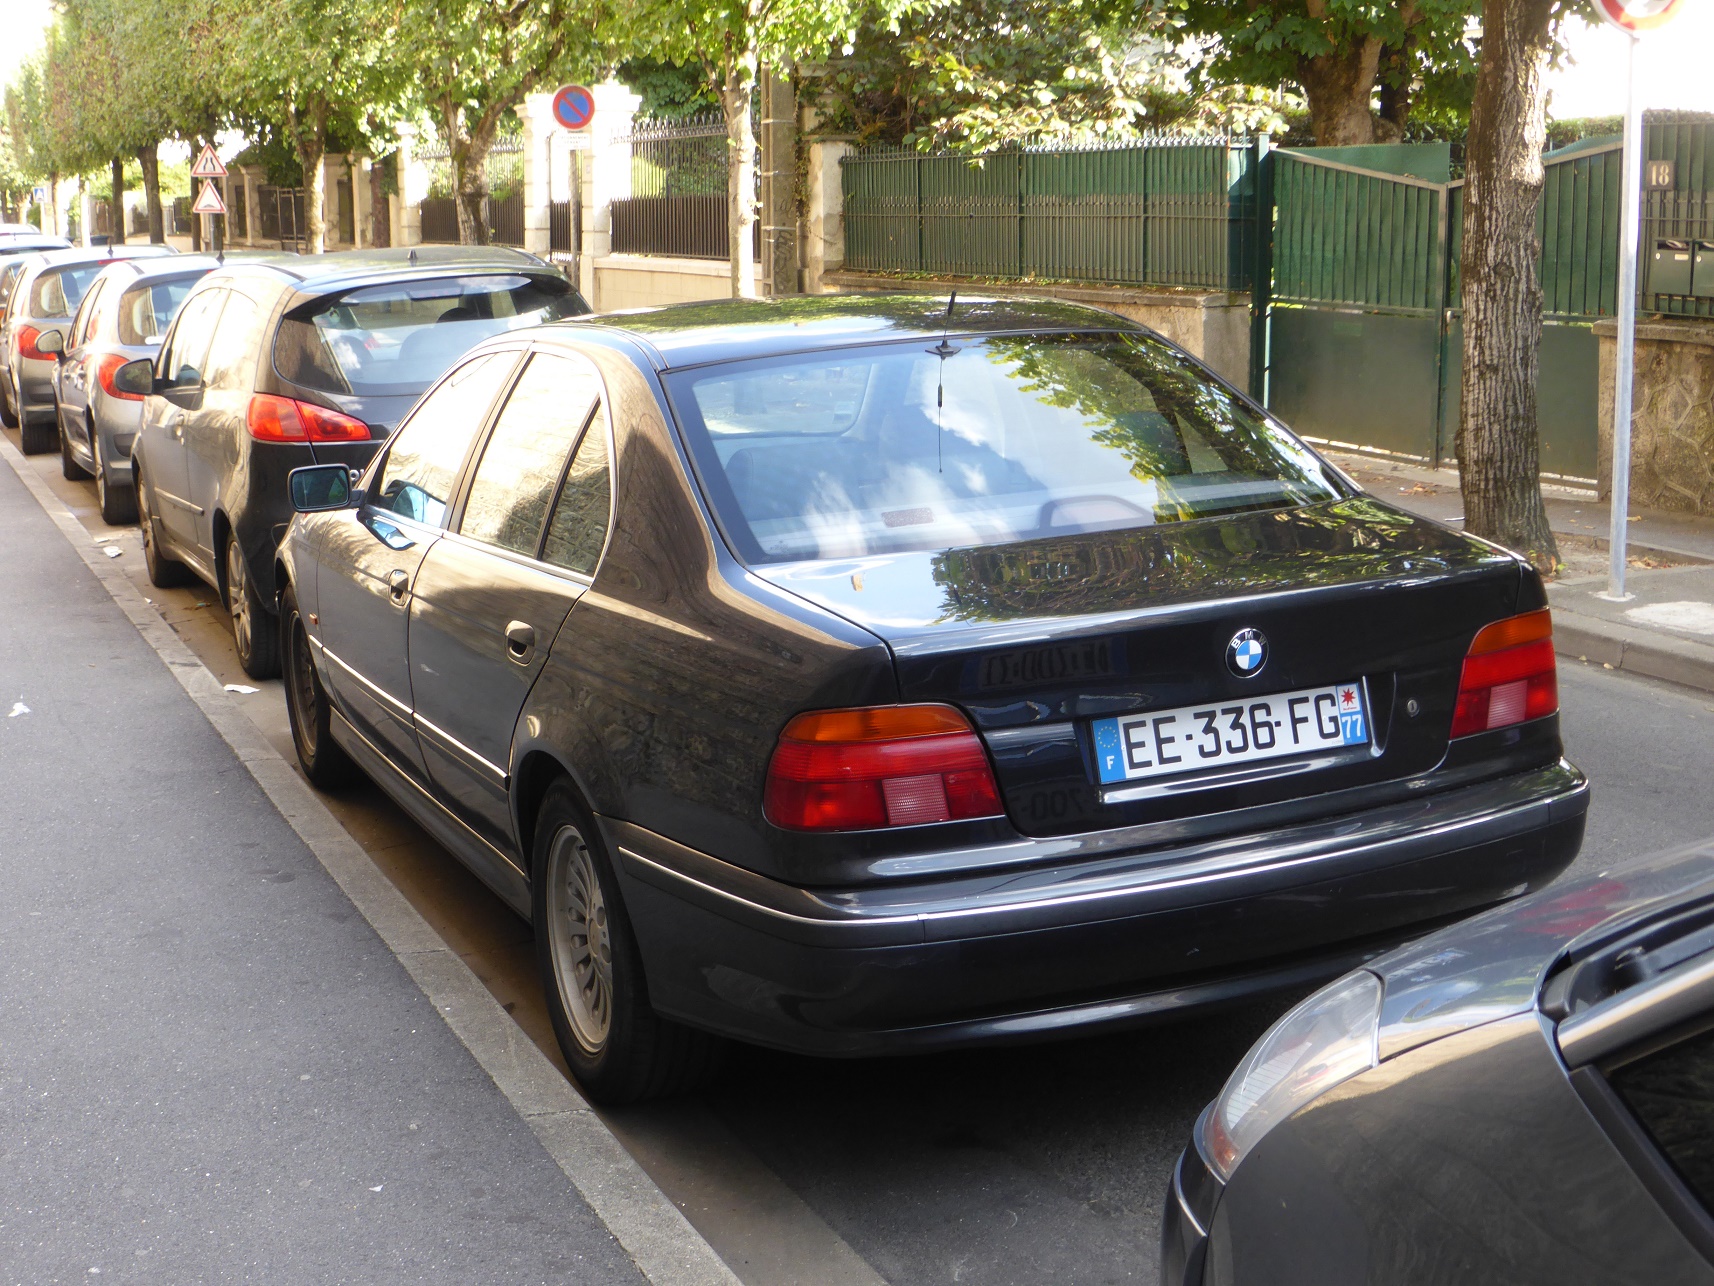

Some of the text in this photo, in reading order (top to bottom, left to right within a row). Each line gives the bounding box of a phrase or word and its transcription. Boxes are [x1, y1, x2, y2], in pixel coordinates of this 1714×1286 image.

[1651, 164, 1669, 186] 18
[1230, 630, 1267, 649] BMW
[1341, 714, 1362, 739] 77
[1106, 755, 1115, 770] F
